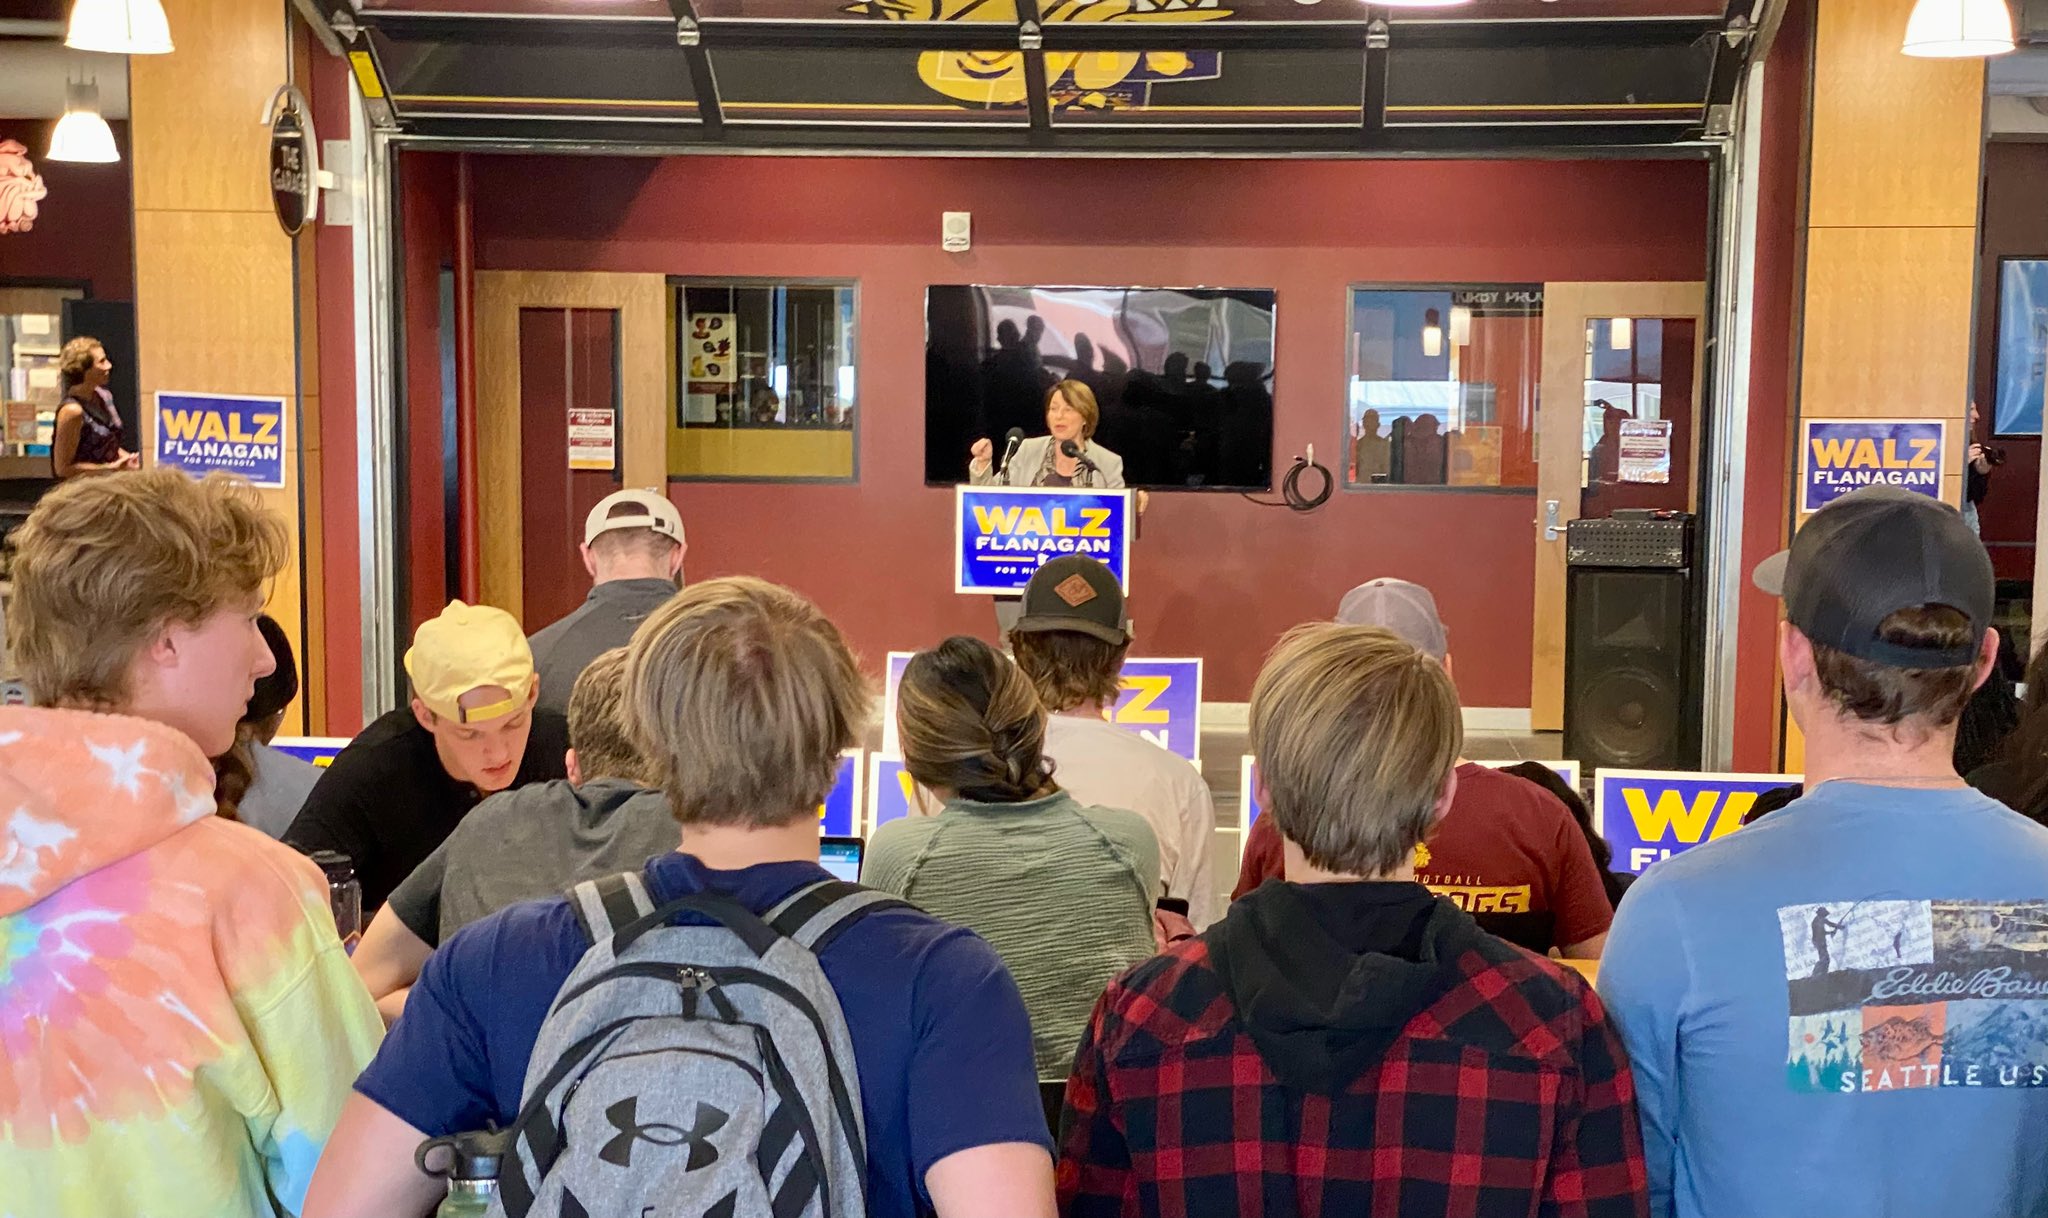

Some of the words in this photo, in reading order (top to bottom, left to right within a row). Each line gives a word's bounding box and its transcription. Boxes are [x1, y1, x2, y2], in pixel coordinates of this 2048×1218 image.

[281, 145, 299, 170] THE
[161, 408, 279, 445] WALZ
[164, 440, 279, 460] FLANAGAN
[183, 456, 202, 465] FOR
[204, 457, 256, 467] MINNESOTA
[1811, 438, 1938, 469] WALZ
[1813, 470, 1935, 485] FLANAGAN
[972, 506, 1111, 537] WALZ
[976, 536, 1111, 553] FLANAGAN
[995, 566, 1017, 575] FOR
[1621, 788, 1759, 844] WA
[1414, 874, 1483, 886] OOTBALL
[1862, 967, 1965, 1004] Eddie
[1966, 966, 2048, 998] Baue
[1840, 1064, 1982, 1093] SEATTLE
[1999, 1064, 2048, 1086] US
